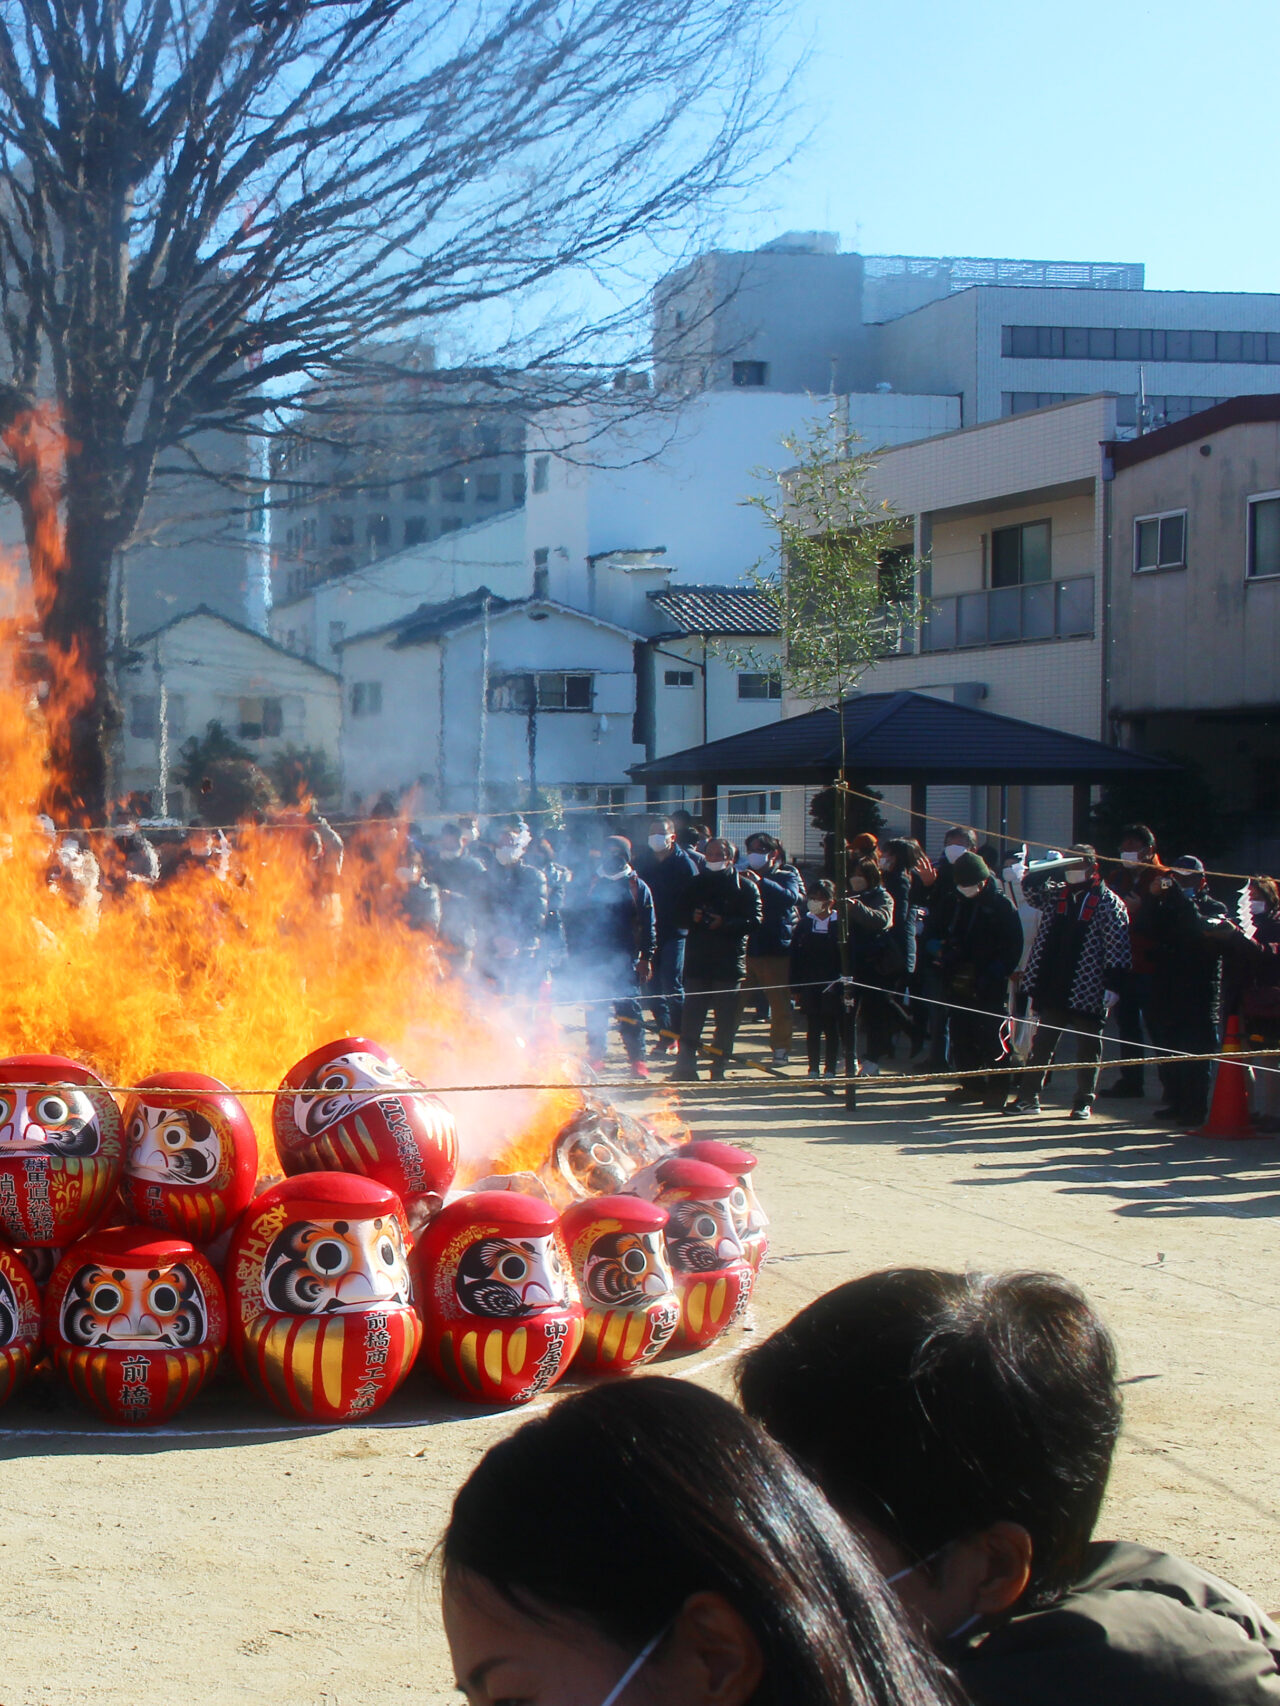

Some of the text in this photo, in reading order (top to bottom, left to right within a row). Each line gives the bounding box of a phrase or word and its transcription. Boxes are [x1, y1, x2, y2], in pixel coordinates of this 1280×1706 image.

[23, 1157, 54, 1241] 群馬県総務部
[118, 1354, 152, 1423] 前橋市
